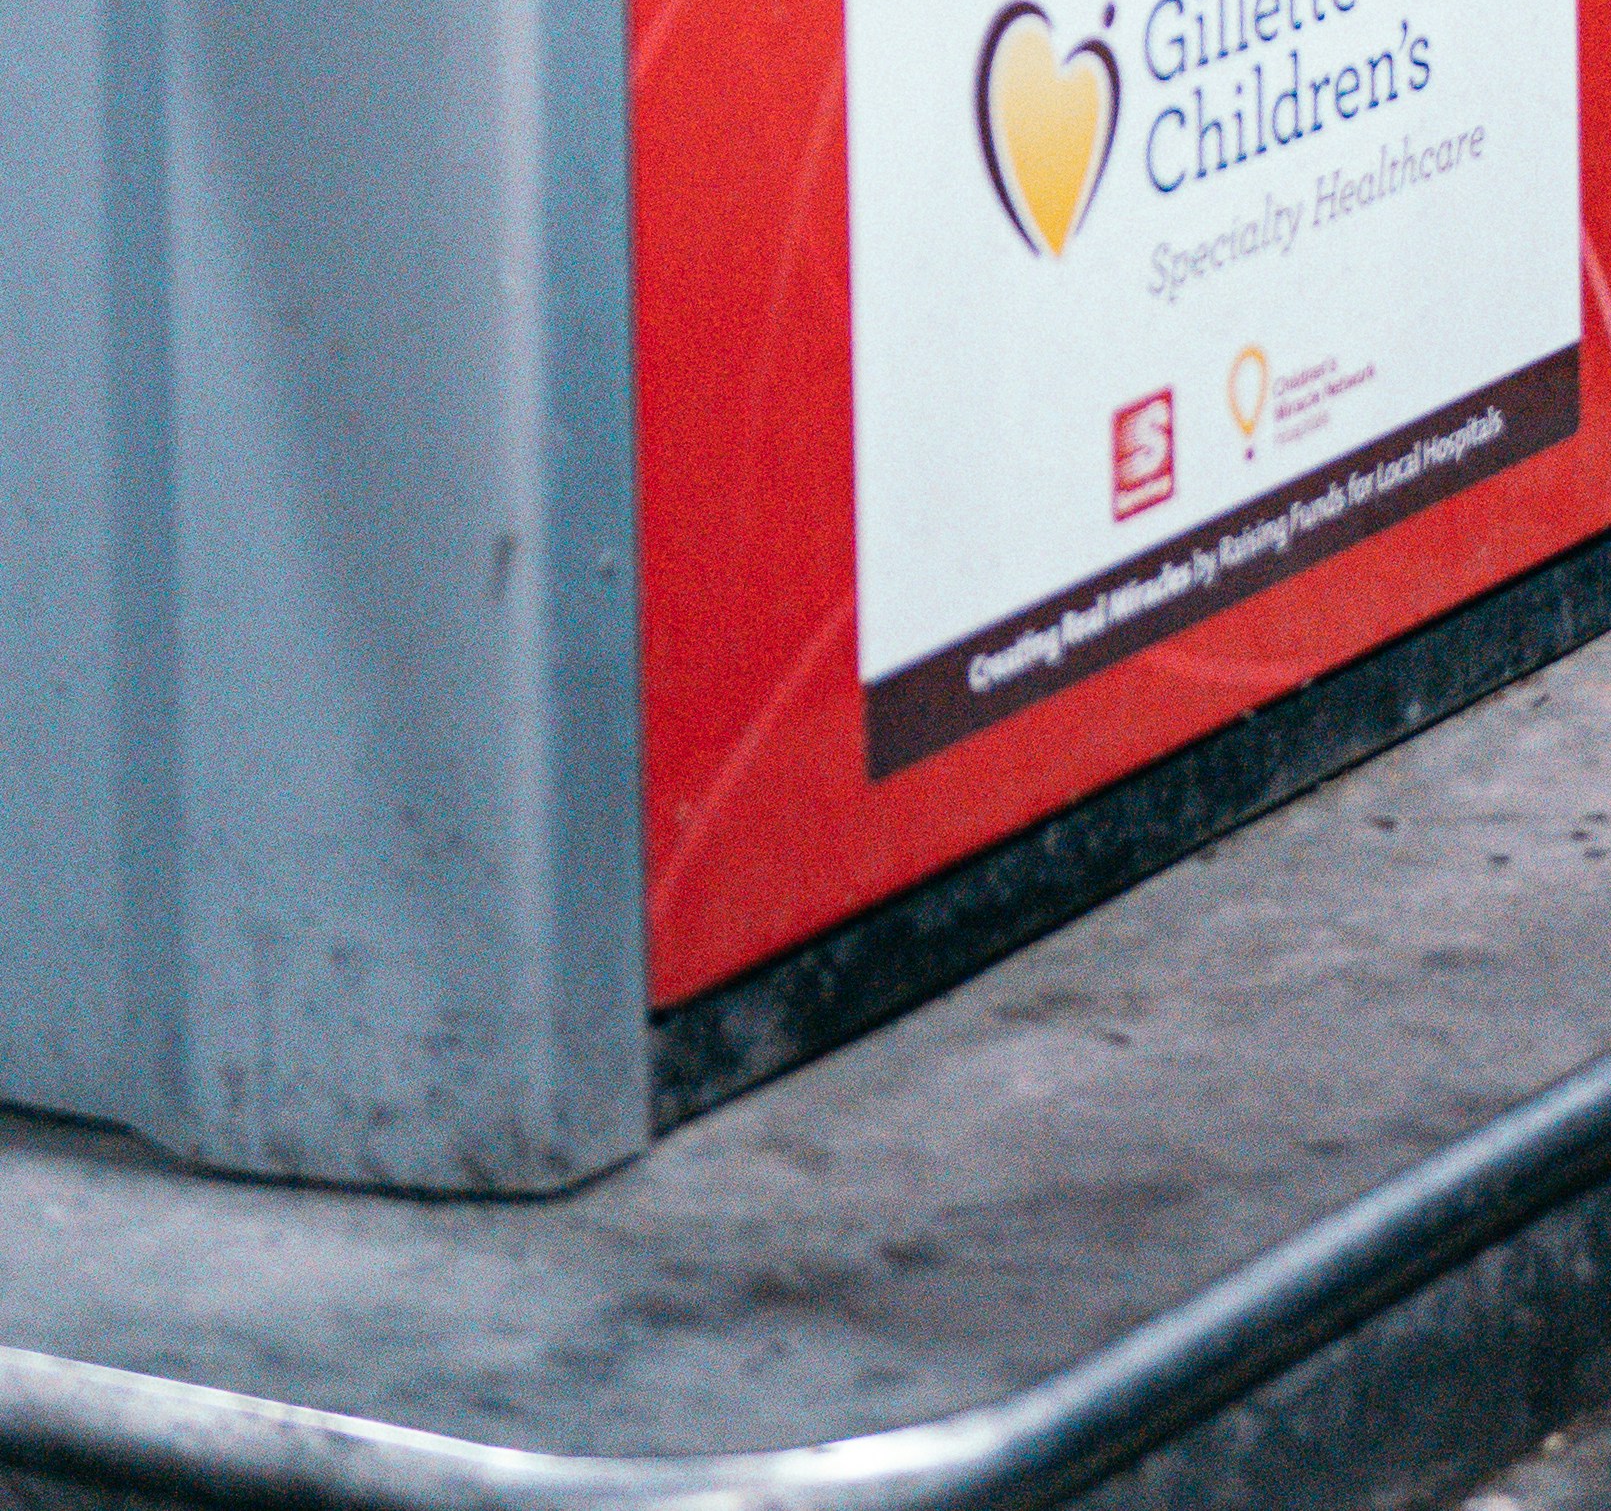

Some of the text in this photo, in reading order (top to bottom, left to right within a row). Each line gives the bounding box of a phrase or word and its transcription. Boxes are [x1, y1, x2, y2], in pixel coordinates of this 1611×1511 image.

[1143, 20, 1433, 195] Children's
[1147, 122, 1488, 303] Specialty Healthcare
[968, 404, 1504, 693] Creating Real Miracles by Raising Funds for Local Hospitals
